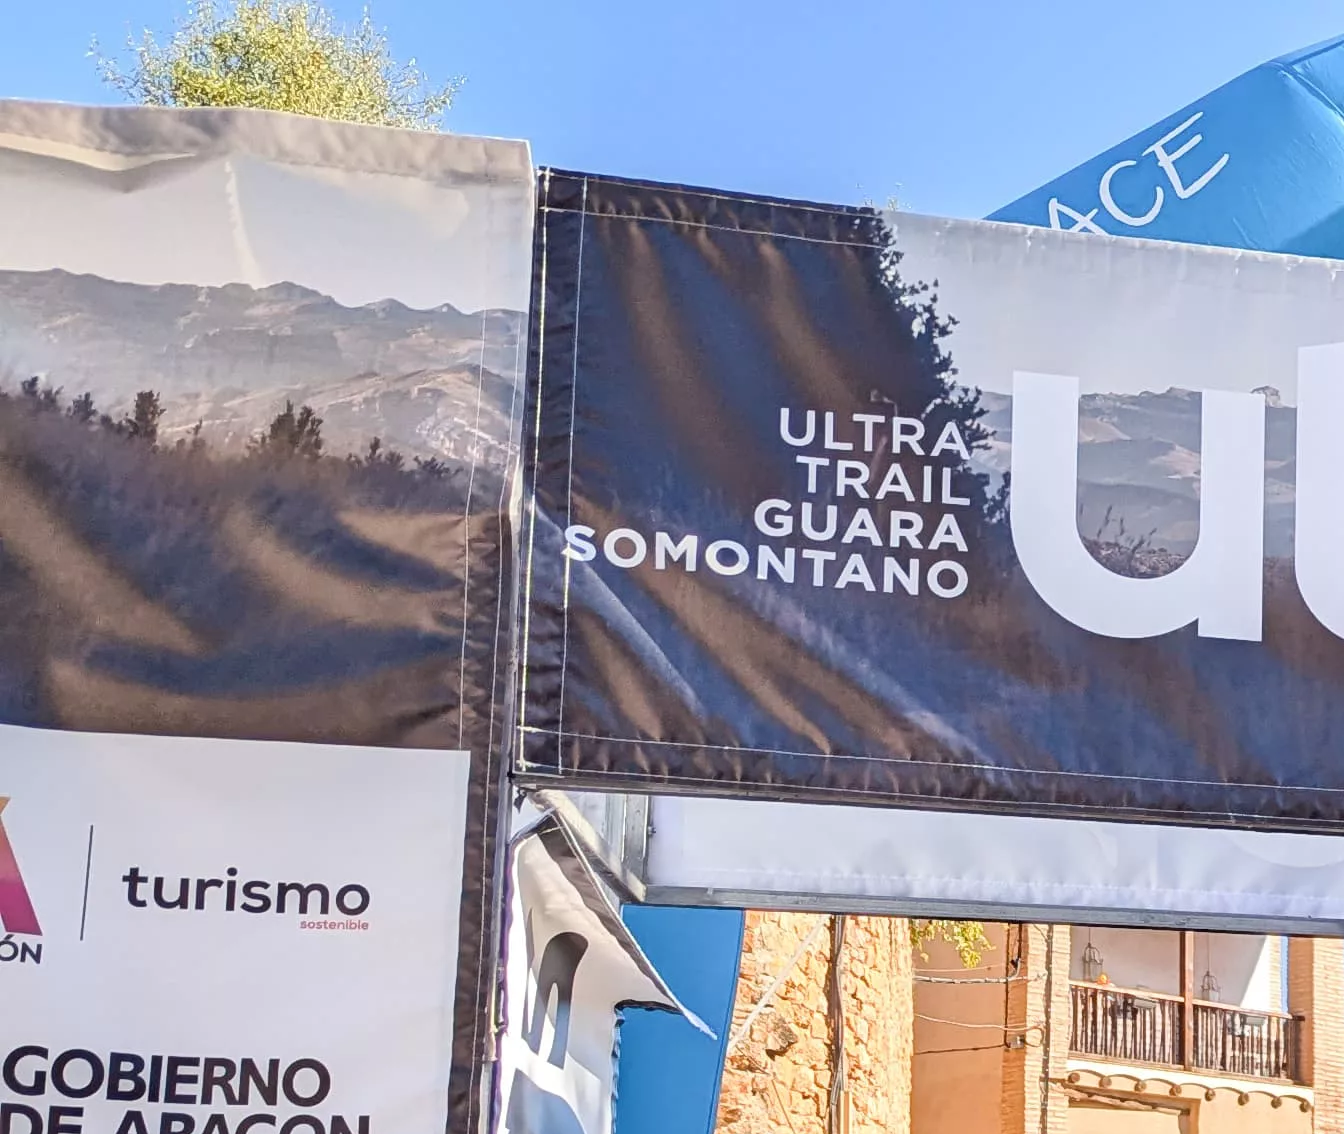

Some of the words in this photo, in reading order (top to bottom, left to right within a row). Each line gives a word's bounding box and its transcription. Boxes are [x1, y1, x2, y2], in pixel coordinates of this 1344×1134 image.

[779, 405, 971, 461] ULTRA
[796, 454, 971, 507] TRAIL
[753, 497, 970, 553] GUARA
[561, 524, 970, 600] SOMONTANO
[122, 866, 371, 917] turismo
[299, 918, 370, 932] sostenible
[2, 1044, 332, 1107] GOBIERNO
